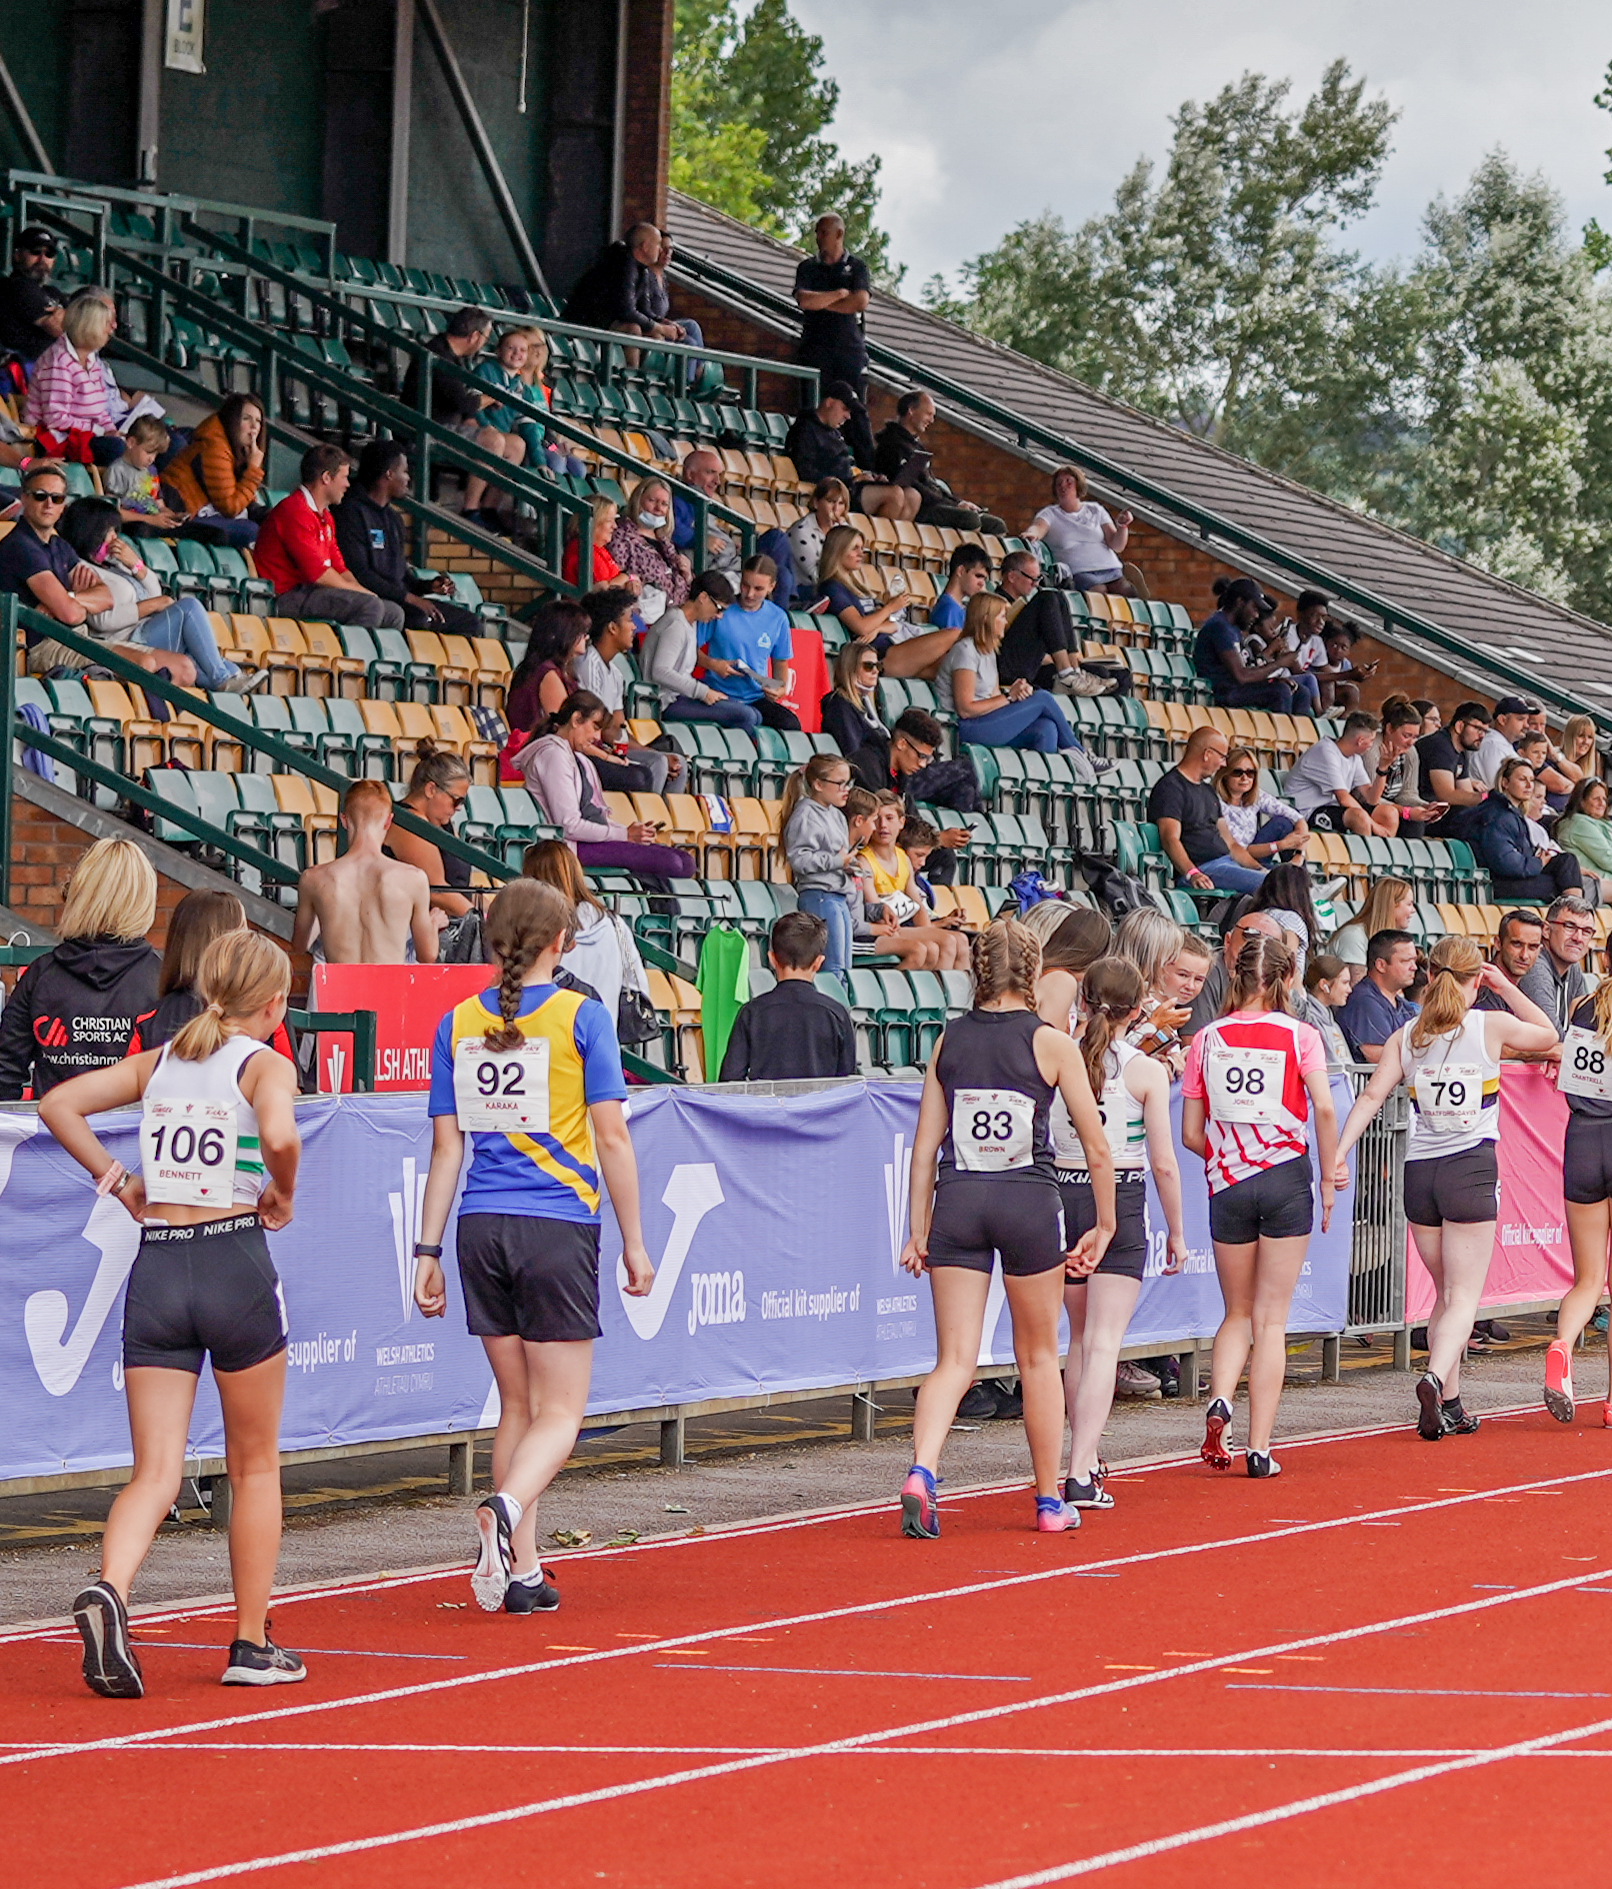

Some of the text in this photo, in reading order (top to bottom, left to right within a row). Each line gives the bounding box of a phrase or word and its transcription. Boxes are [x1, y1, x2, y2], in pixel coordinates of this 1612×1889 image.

[72, 1016, 131, 1030] CHRISTIAN
[72, 1031, 128, 1042] SPORTS AC
[42, 1051, 123, 1066] w.christianm
[374, 1048, 400, 1081] LSH
[1574, 1046, 1605, 1075] 88
[476, 1061, 526, 1096] 92
[1225, 1066, 1265, 1095] 98
[1430, 1080, 1466, 1107] 79
[971, 1110, 1013, 1141] 83
[151, 1125, 226, 1167] 106
[159, 1169, 203, 1181] BENNETT
[144, 1228, 195, 1242] NIKE PRO
[203, 1216, 256, 1237] NIKE PRO
[761, 1289, 794, 1320] Official
[795, 1288, 808, 1317] kit
[808, 1285, 848, 1322] supplier
[849, 1282, 861, 1312] of
[287, 1328, 357, 1374] supplier of
[376, 1342, 435, 1367] WELSH ATHLETICS
